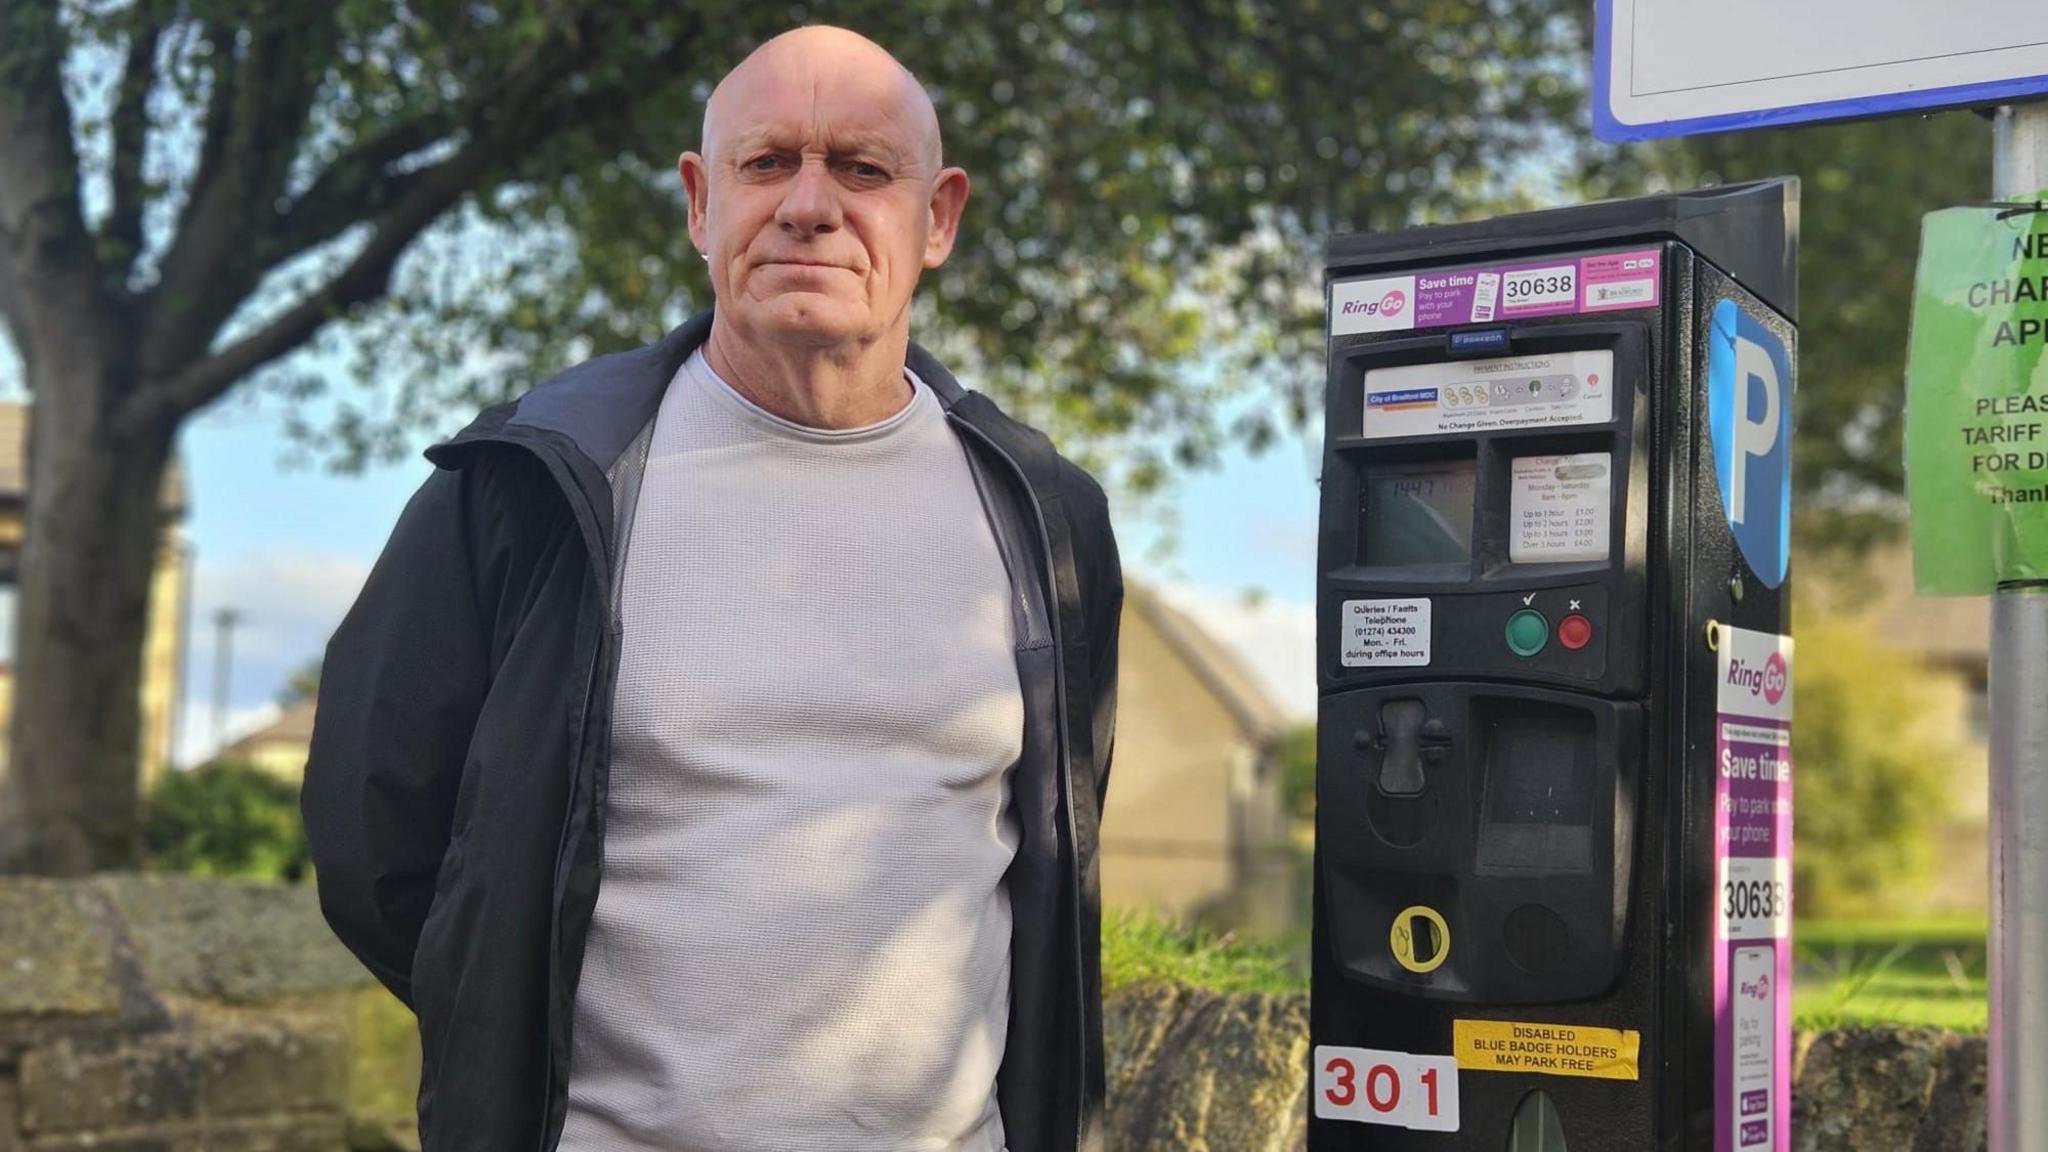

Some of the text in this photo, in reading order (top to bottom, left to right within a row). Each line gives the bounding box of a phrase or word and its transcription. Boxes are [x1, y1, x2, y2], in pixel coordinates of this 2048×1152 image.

[1419, 278, 1446, 290] Save
[1449, 275, 1474, 286] time
[1506, 276, 1572, 297] 30638
[1418, 293, 1432, 301] Pay
[1444, 289, 1461, 299] park
[1418, 301, 1453, 311] with your
[1417, 313, 1442, 323] phone
[1992, 319, 2048, 348] AP
[1449, 419, 1475, 430] Change
[1499, 415, 1547, 427] Overpayment
[1729, 336, 1781, 524] P
[1961, 424, 2042, 445] TARIFF
[1973, 453, 2020, 473] FOR
[1524, 510, 1533, 519] Up
[1535, 510, 1542, 518] to
[1524, 520, 1533, 529] Up
[1549, 520, 1568, 528] hours
[1523, 530, 1532, 540] Up
[1549, 529, 1568, 538] hours
[1547, 539, 1565, 548] hours
[1364, 617, 1406, 625] Telephone
[1355, 627, 1416, 637] (01274) 434300
[1346, 650, 1373, 660] during
[1375, 649, 1398, 658] office
[1722, 748, 1790, 782] Save time
[1721, 793, 1738, 817] Pay
[1740, 797, 1749, 812] to
[1751, 797, 1769, 819] park
[1721, 823, 1770, 846] your phone
[1513, 1027, 1575, 1041] DISABLED
[1474, 1039, 1617, 1059] BLUE BADGE HOLDERS
[1496, 1055, 1593, 1071] MAY PARK FREE
[1325, 1057, 1438, 1116] 301
